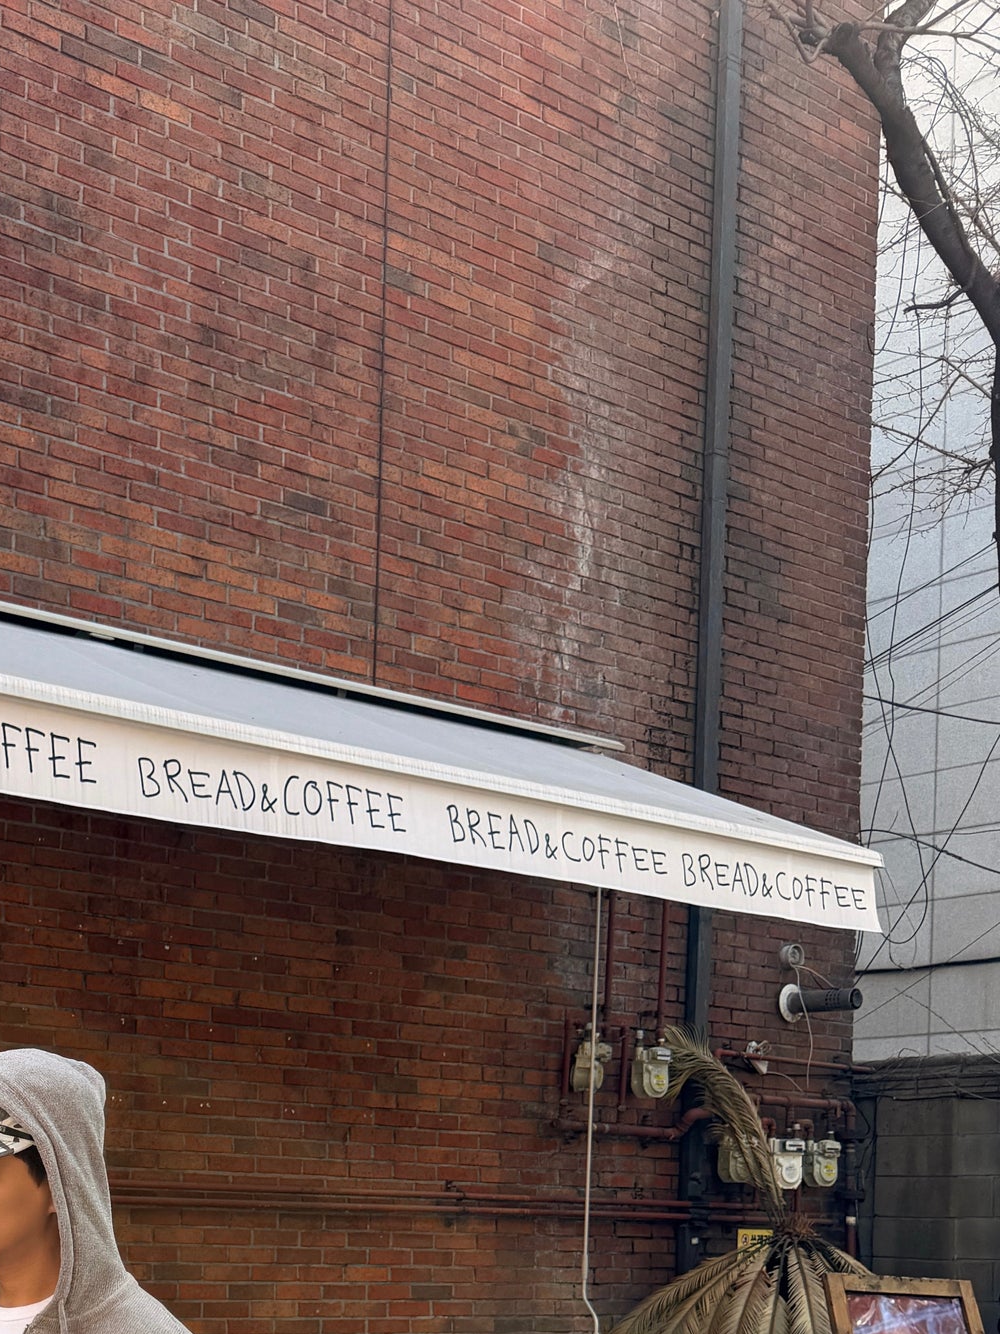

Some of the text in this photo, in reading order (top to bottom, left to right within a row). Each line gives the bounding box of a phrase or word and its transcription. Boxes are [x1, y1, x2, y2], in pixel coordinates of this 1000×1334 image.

[138, 757, 407, 832] BREAD&COFFEE
[446, 804, 668, 876] BREAD&COFFEE
[682, 853, 867, 911] BREAD&COFFEE
